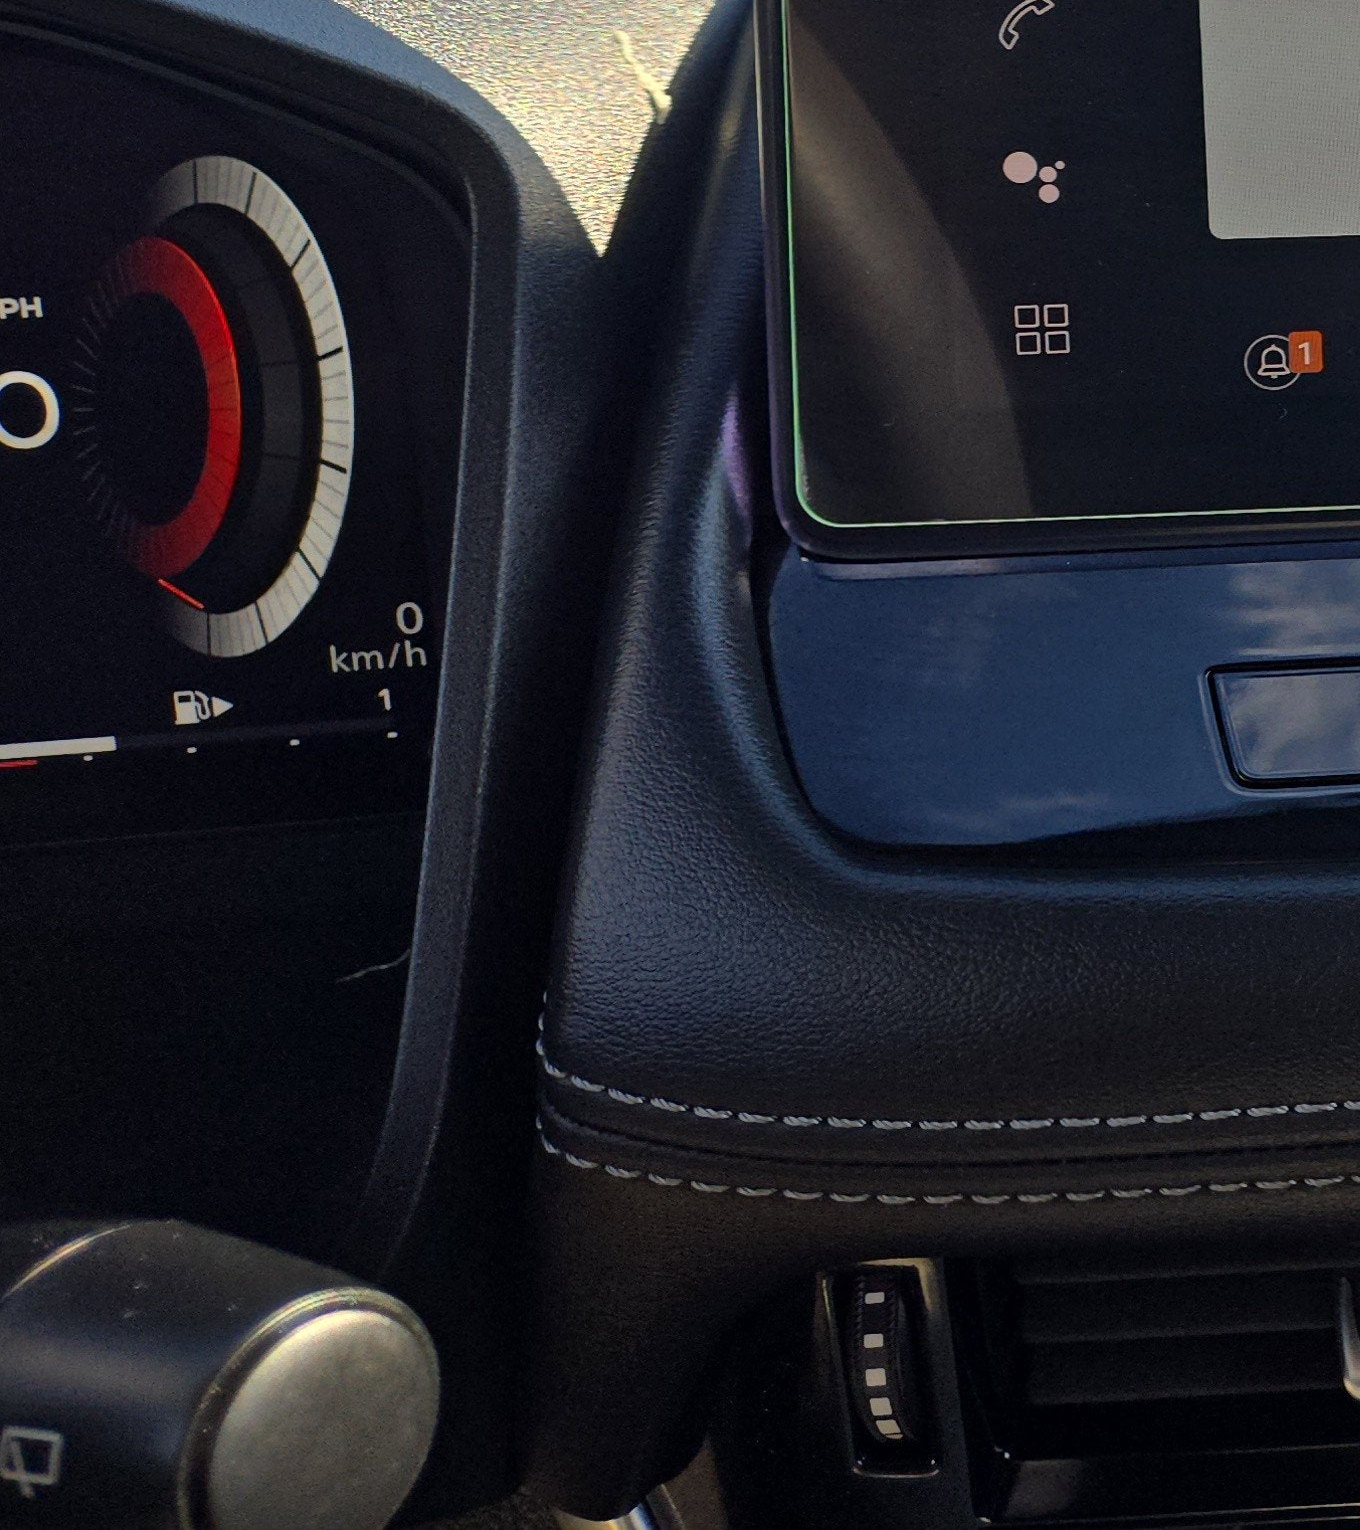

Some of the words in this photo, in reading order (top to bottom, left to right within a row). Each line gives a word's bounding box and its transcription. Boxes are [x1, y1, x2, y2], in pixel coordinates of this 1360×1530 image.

[1298, 341, 1311, 365] 1
[395, 601, 424, 635] 0
[329, 639, 428, 673] km/h
[377, 688, 392, 711] 1
